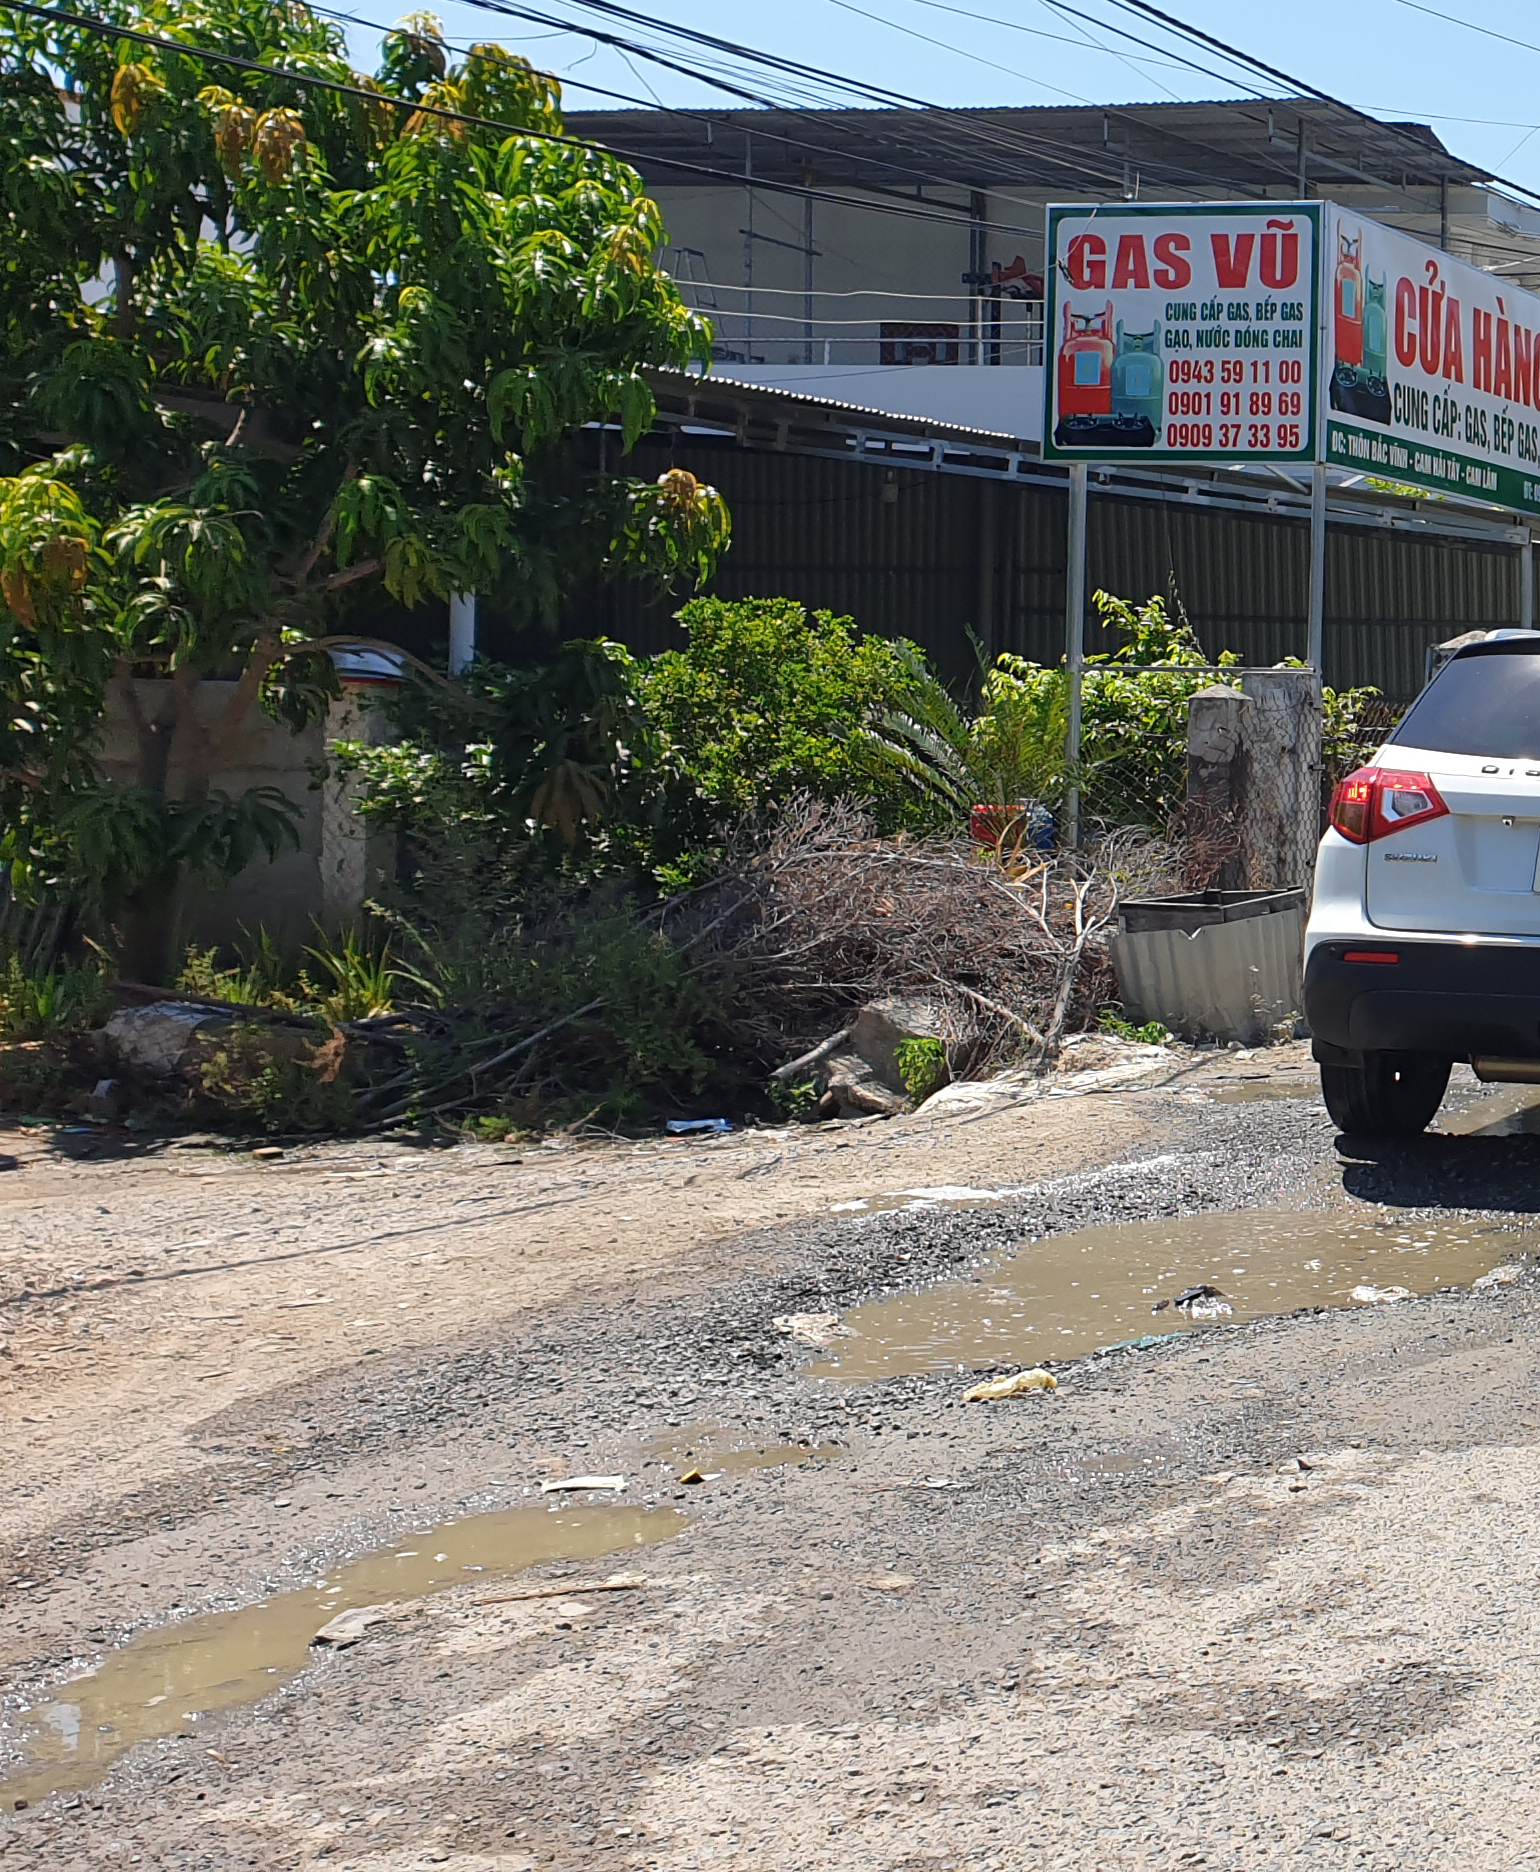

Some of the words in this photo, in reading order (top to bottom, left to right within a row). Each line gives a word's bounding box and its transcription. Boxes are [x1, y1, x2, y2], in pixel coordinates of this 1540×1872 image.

[1067, 233, 1192, 290] GAS
[1210, 219, 1299, 290] VŨ
[1165, 302, 1197, 321] CUNG
[1200, 294, 1224, 321] CẤP
[1227, 302, 1252, 323] GAS,
[1255, 294, 1278, 321] BẾP
[1281, 302, 1304, 321] GAS
[1394, 259, 1464, 384] CỬA
[1164, 329, 1193, 353] GẠO,
[1196, 324, 1231, 348] NƯỚC
[1272, 329, 1303, 348] CHAI
[1169, 360, 1215, 384] 0943
[1220, 360, 1244, 384] 59
[1250, 360, 1271, 384] 11
[1278, 360, 1302, 384] 00
[1168, 392, 1212, 416] 0901
[1219, 392, 1241, 416] 91
[1249, 392, 1272, 416] 89
[1278, 392, 1301, 416] 69
[1166, 423, 1212, 448] 0909
[1219, 423, 1241, 448] 37
[1248, 423, 1271, 448] 33
[1277, 423, 1300, 448] 95
[1394, 382, 1428, 431] CUNG
[1432, 384, 1461, 440] CẤP:
[1465, 404, 1490, 454] GAS,
[1493, 405, 1515, 455] BẾP
[1518, 421, 1540, 468] GAS,
[1347, 432, 1370, 460] THÔN
[1371, 434, 1388, 464] BẮC
